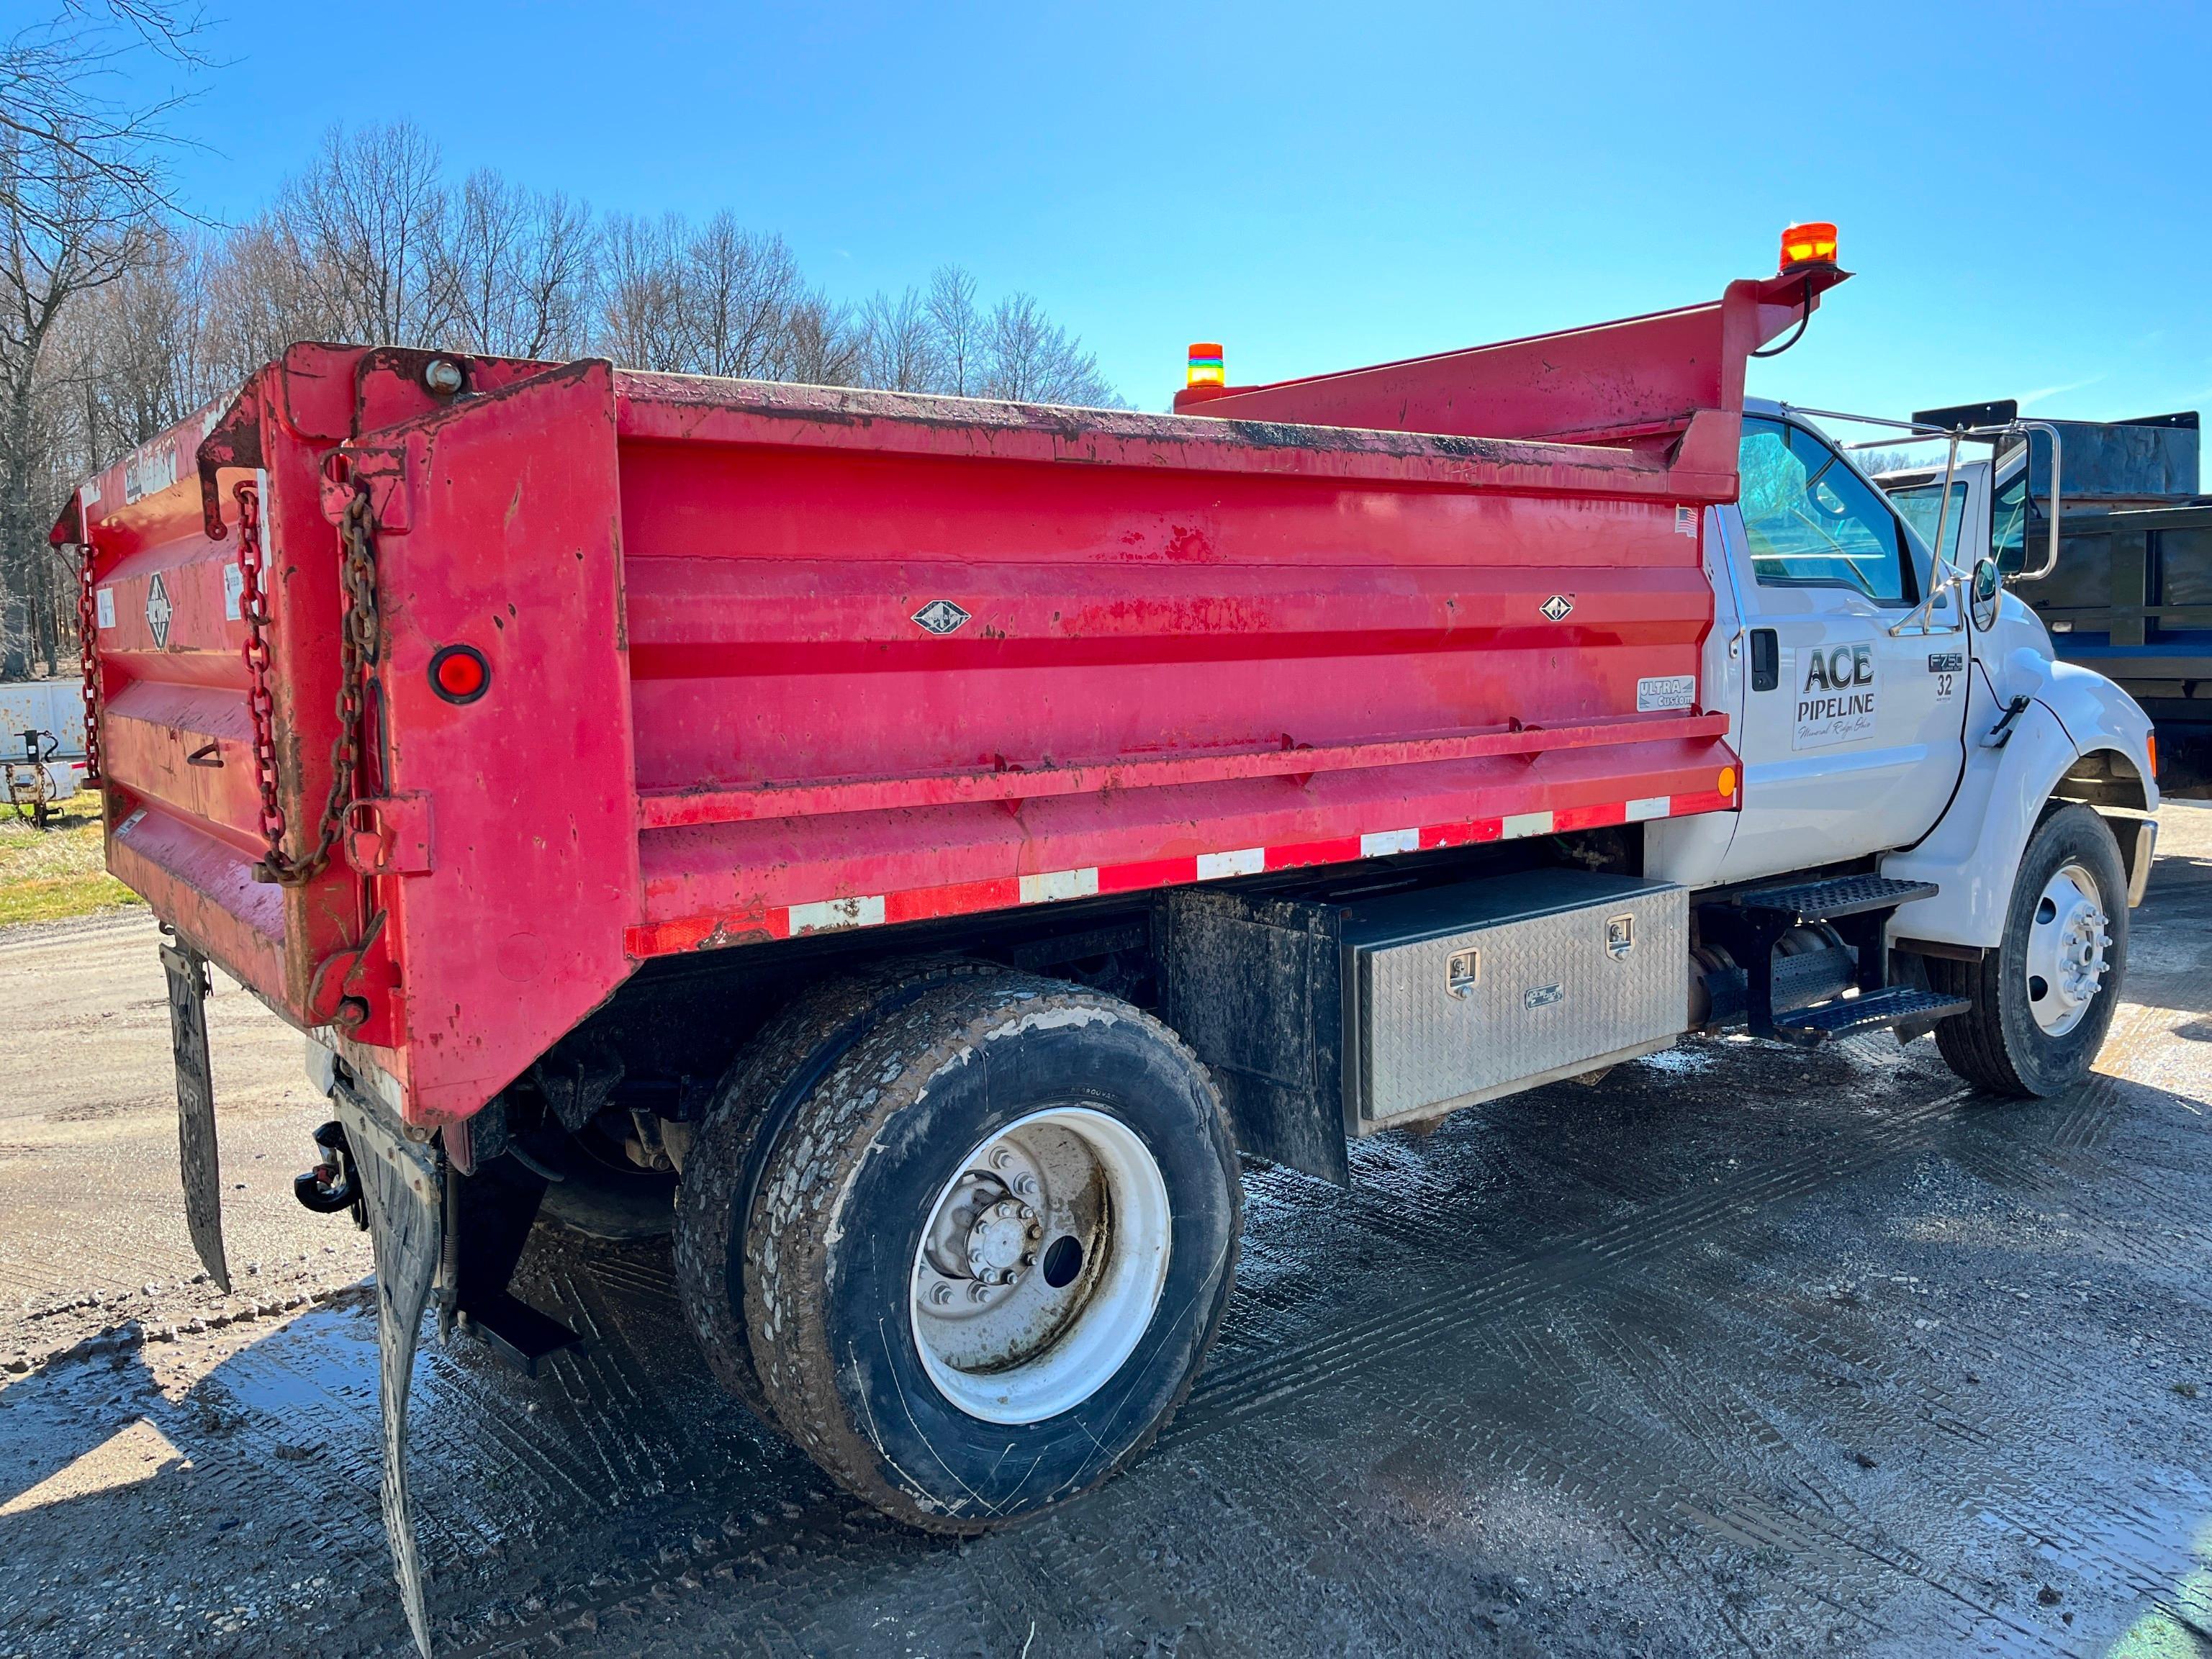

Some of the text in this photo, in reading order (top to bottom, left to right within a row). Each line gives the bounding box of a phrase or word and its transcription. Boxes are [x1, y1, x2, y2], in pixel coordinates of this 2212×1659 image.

[1803, 644, 1874, 694] ACE
[1640, 679, 1681, 696] ULTRA
[1937, 674, 1952, 696] 32
[1658, 695, 1692, 707] Custom
[1798, 693, 1874, 722] PIPELINE
[1799, 722, 1832, 739] Mineral
[1854, 717, 1871, 731] Ohio
